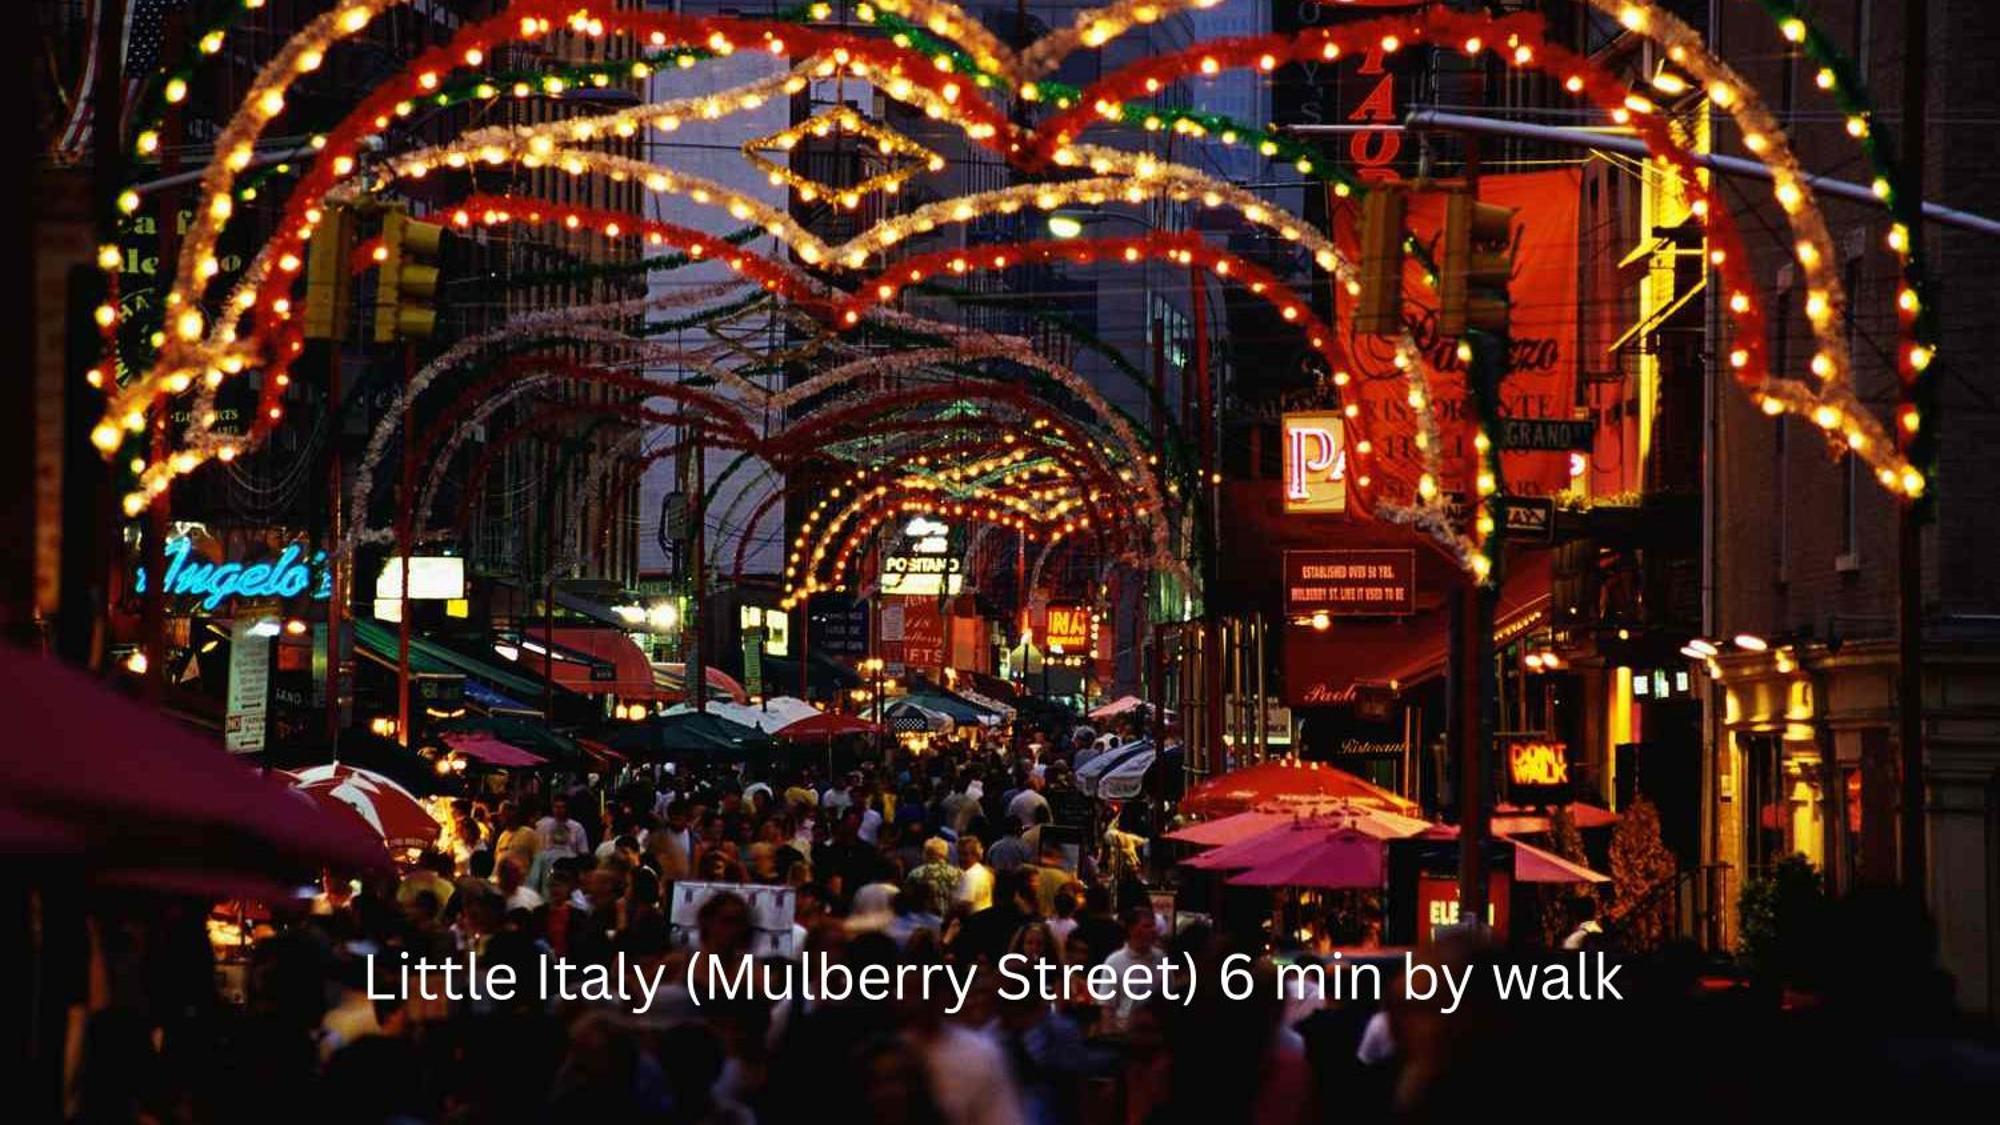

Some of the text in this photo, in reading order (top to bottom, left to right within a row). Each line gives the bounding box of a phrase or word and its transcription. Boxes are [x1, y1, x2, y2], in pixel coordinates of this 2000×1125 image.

[1506, 420, 1571, 448] GRAND
[1302, 564, 1347, 579] ESTABLISHED
[1348, 564, 1366, 579] OVER
[1384, 587, 1394, 601] TO
[1513, 761, 1568, 784] WALK
